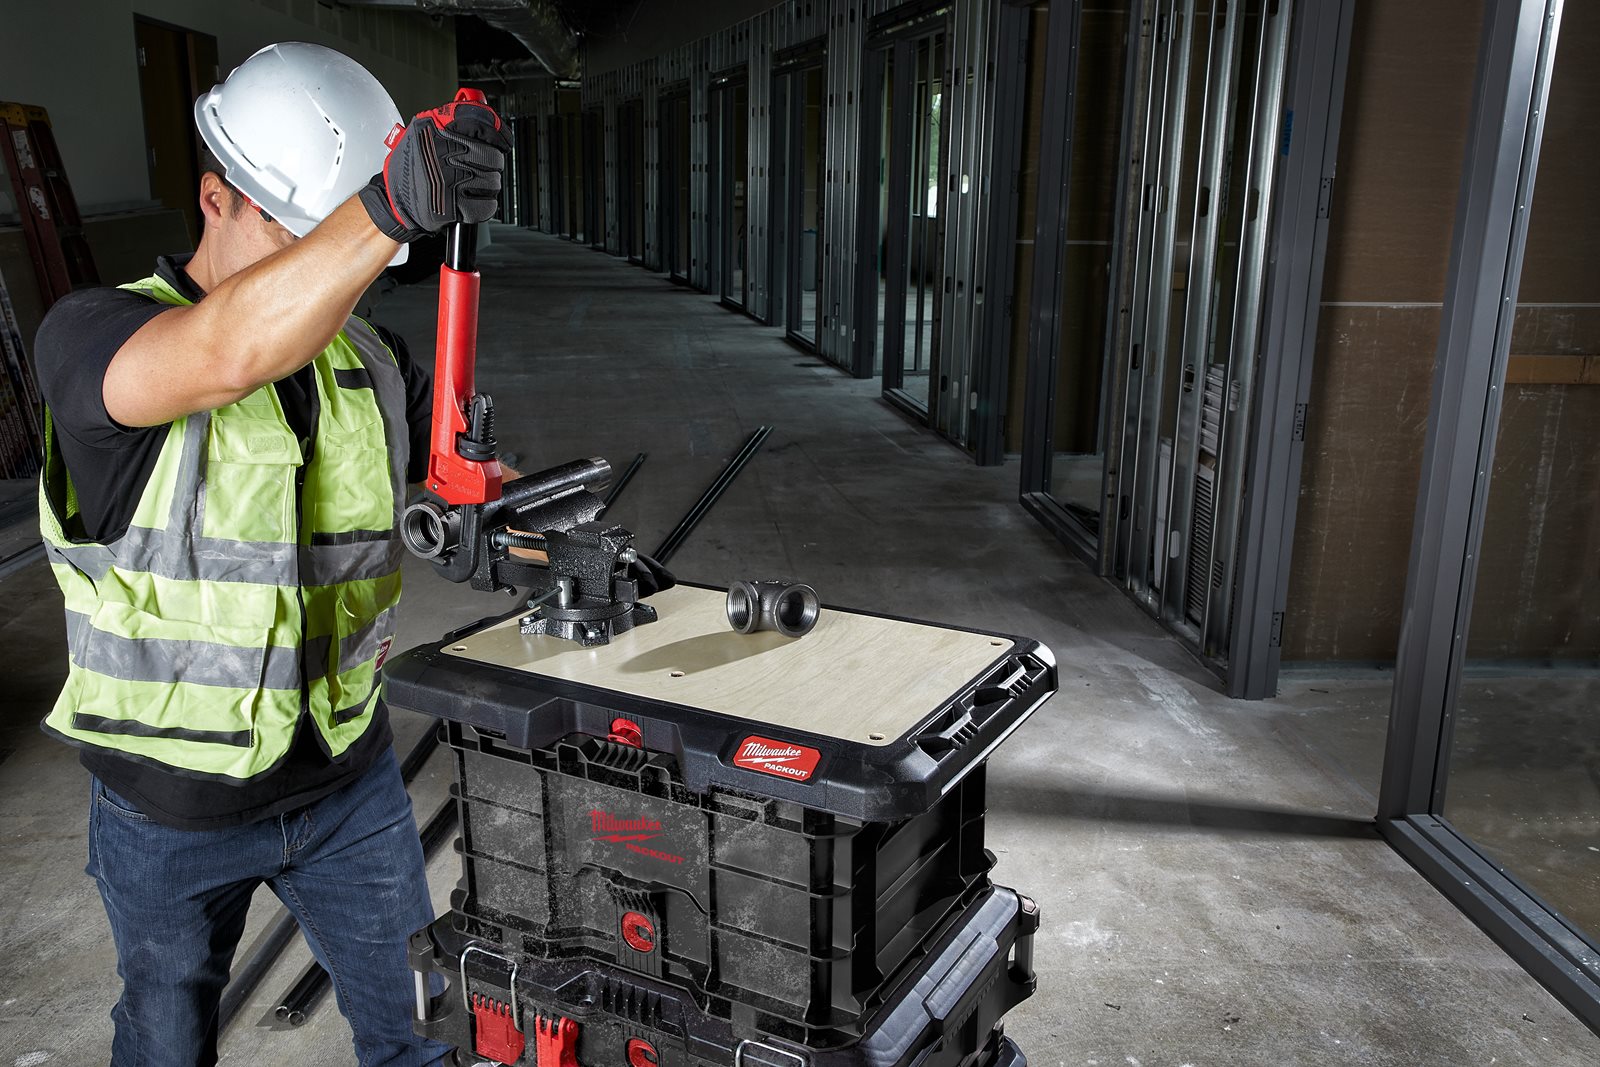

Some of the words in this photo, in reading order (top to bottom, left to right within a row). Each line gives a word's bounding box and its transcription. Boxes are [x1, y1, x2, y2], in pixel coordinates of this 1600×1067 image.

[742, 742, 802, 757] Milwaukee
[763, 762, 808, 777] PACKOUT
[587, 808, 663, 832] Milwaukee
[625, 843, 685, 865] PACKOUT
